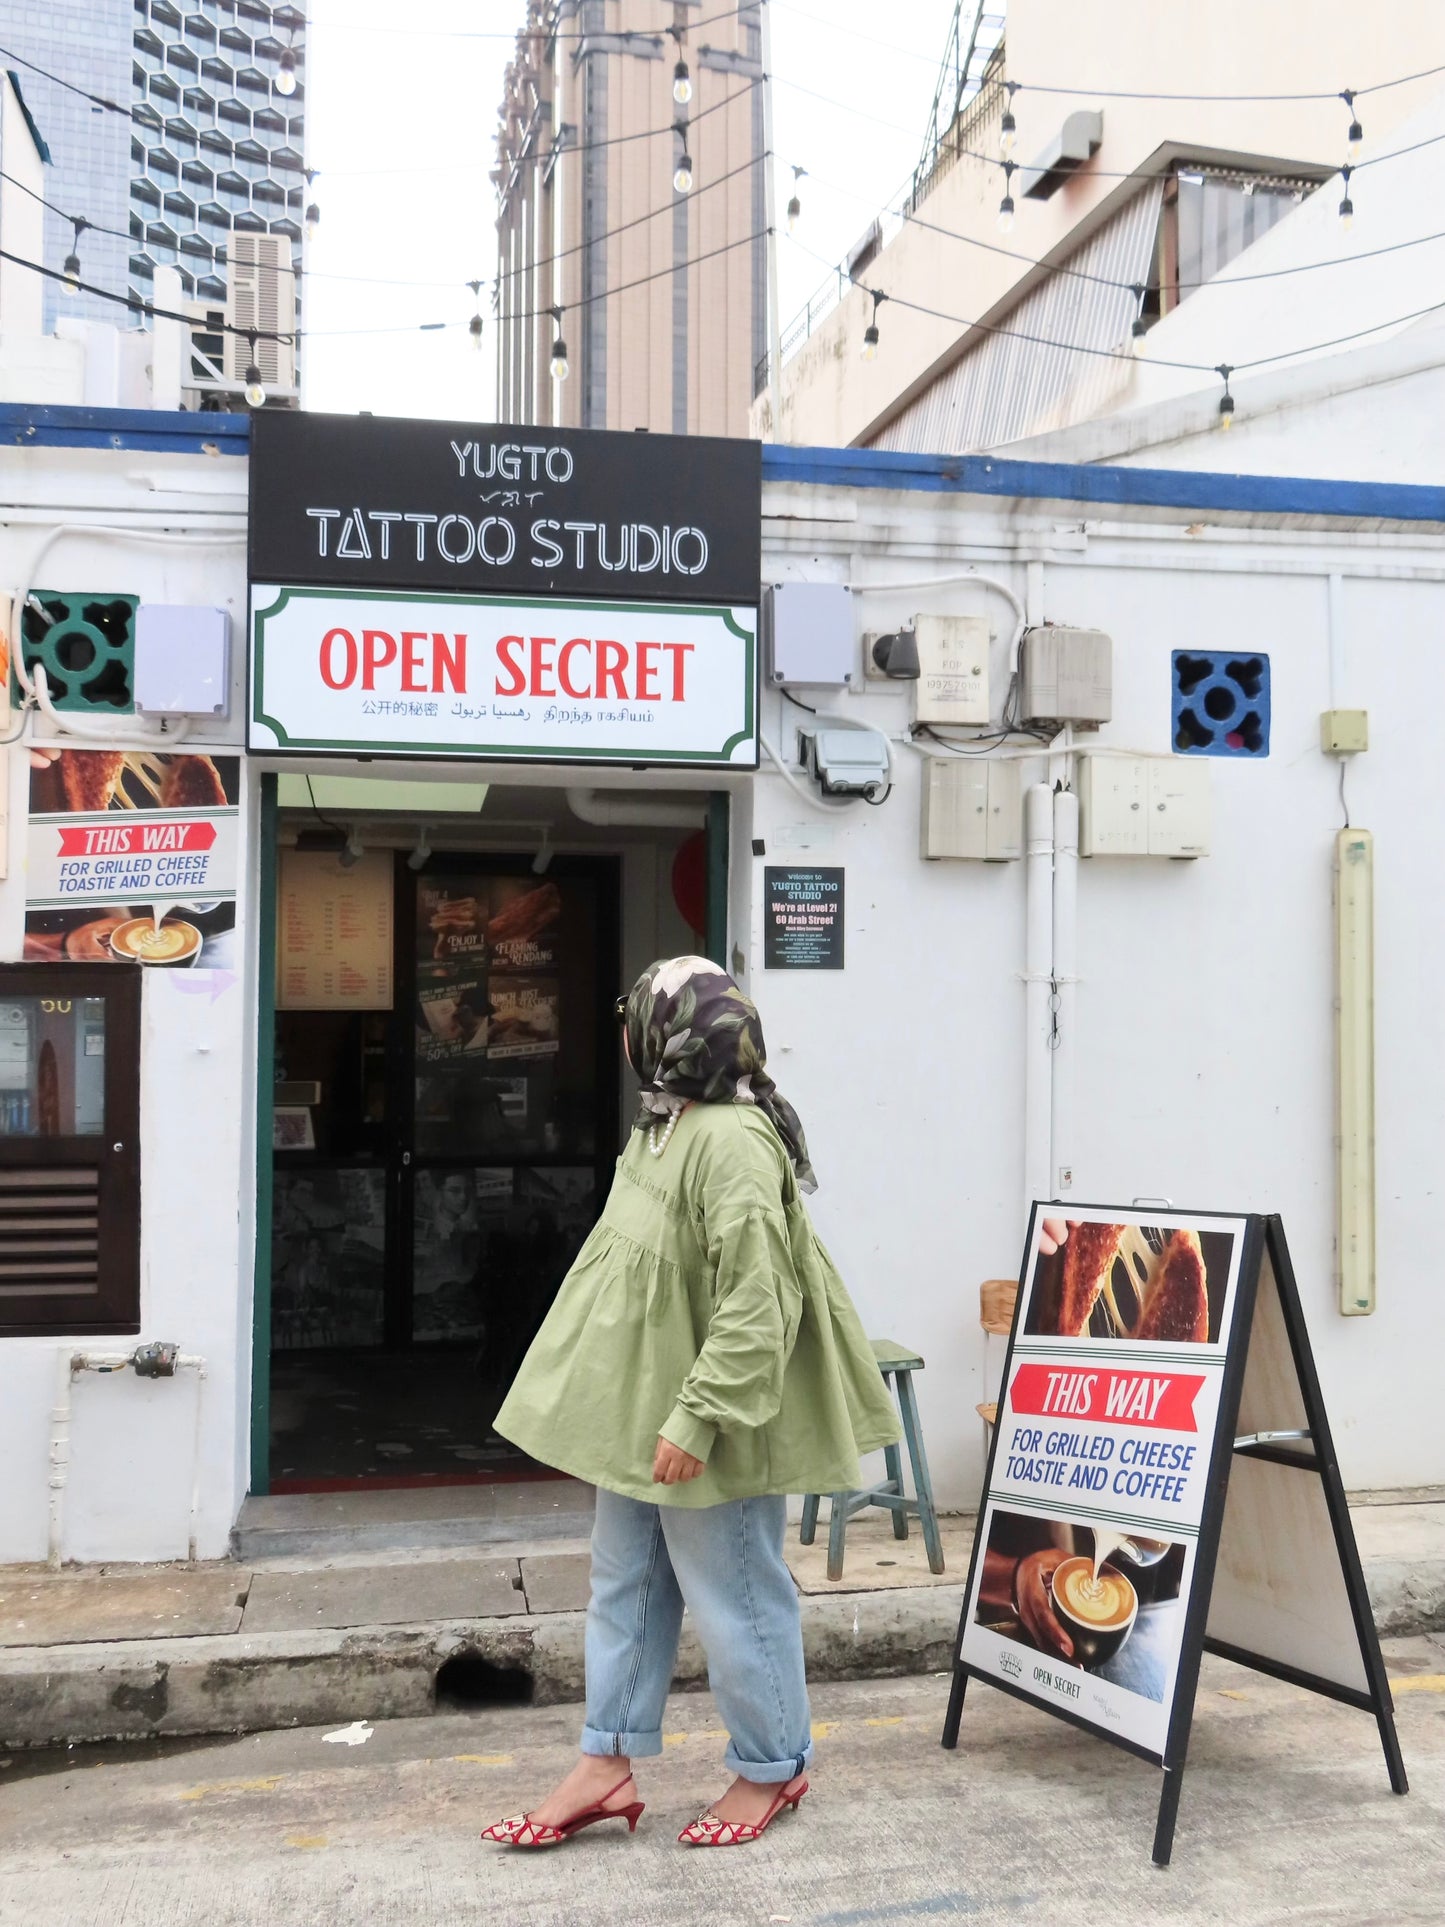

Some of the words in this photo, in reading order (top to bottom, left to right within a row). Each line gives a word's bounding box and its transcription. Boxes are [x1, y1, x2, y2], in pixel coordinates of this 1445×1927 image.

[450, 440, 574, 483] YUGTO
[306, 507, 516, 566] TATTOO
[530, 519, 709, 575] STUDIO
[319, 627, 468, 695] OPEN
[495, 635, 695, 702] SECRET
[362, 699, 439, 717] 公开的秘密
[84, 828, 132, 855] THIS
[143, 825, 191, 851] WAY
[60, 860, 89, 877] FOR
[94, 858, 152, 875] GRILLED
[156, 855, 210, 872] CHEESE
[58, 876, 116, 893] TOASTIE
[119, 874, 150, 889] AND
[155, 871, 207, 887] COFFEE
[804, 882, 838, 891] TATTOO
[788, 891, 821, 900] STUDIO
[771, 902, 796, 912] We're
[797, 903, 805, 912] at
[806, 903, 828, 912] Level
[775, 914, 787, 925] 60
[788, 915, 807, 925] Arab
[808, 915, 834, 925] Street
[447, 934, 477, 947] ENJOY
[495, 941, 538, 955] FLAMING
[509, 950, 553, 966] RENDANG
[491, 991, 516, 1007] LUNCH
[1042, 1372, 1098, 1415] THIS
[1104, 1376, 1171, 1421] WAY
[1011, 1428, 1042, 1453] FOR
[1045, 1431, 1115, 1461] GRILLED
[1119, 1439, 1196, 1472] CHEESE
[1005, 1455, 1068, 1486] TOASTIE
[1068, 1464, 1108, 1491] AND
[1112, 1470, 1187, 1503] COFFEE
[1033, 1666, 1053, 1686] OPEN
[1054, 1675, 1082, 1699] SECRET
